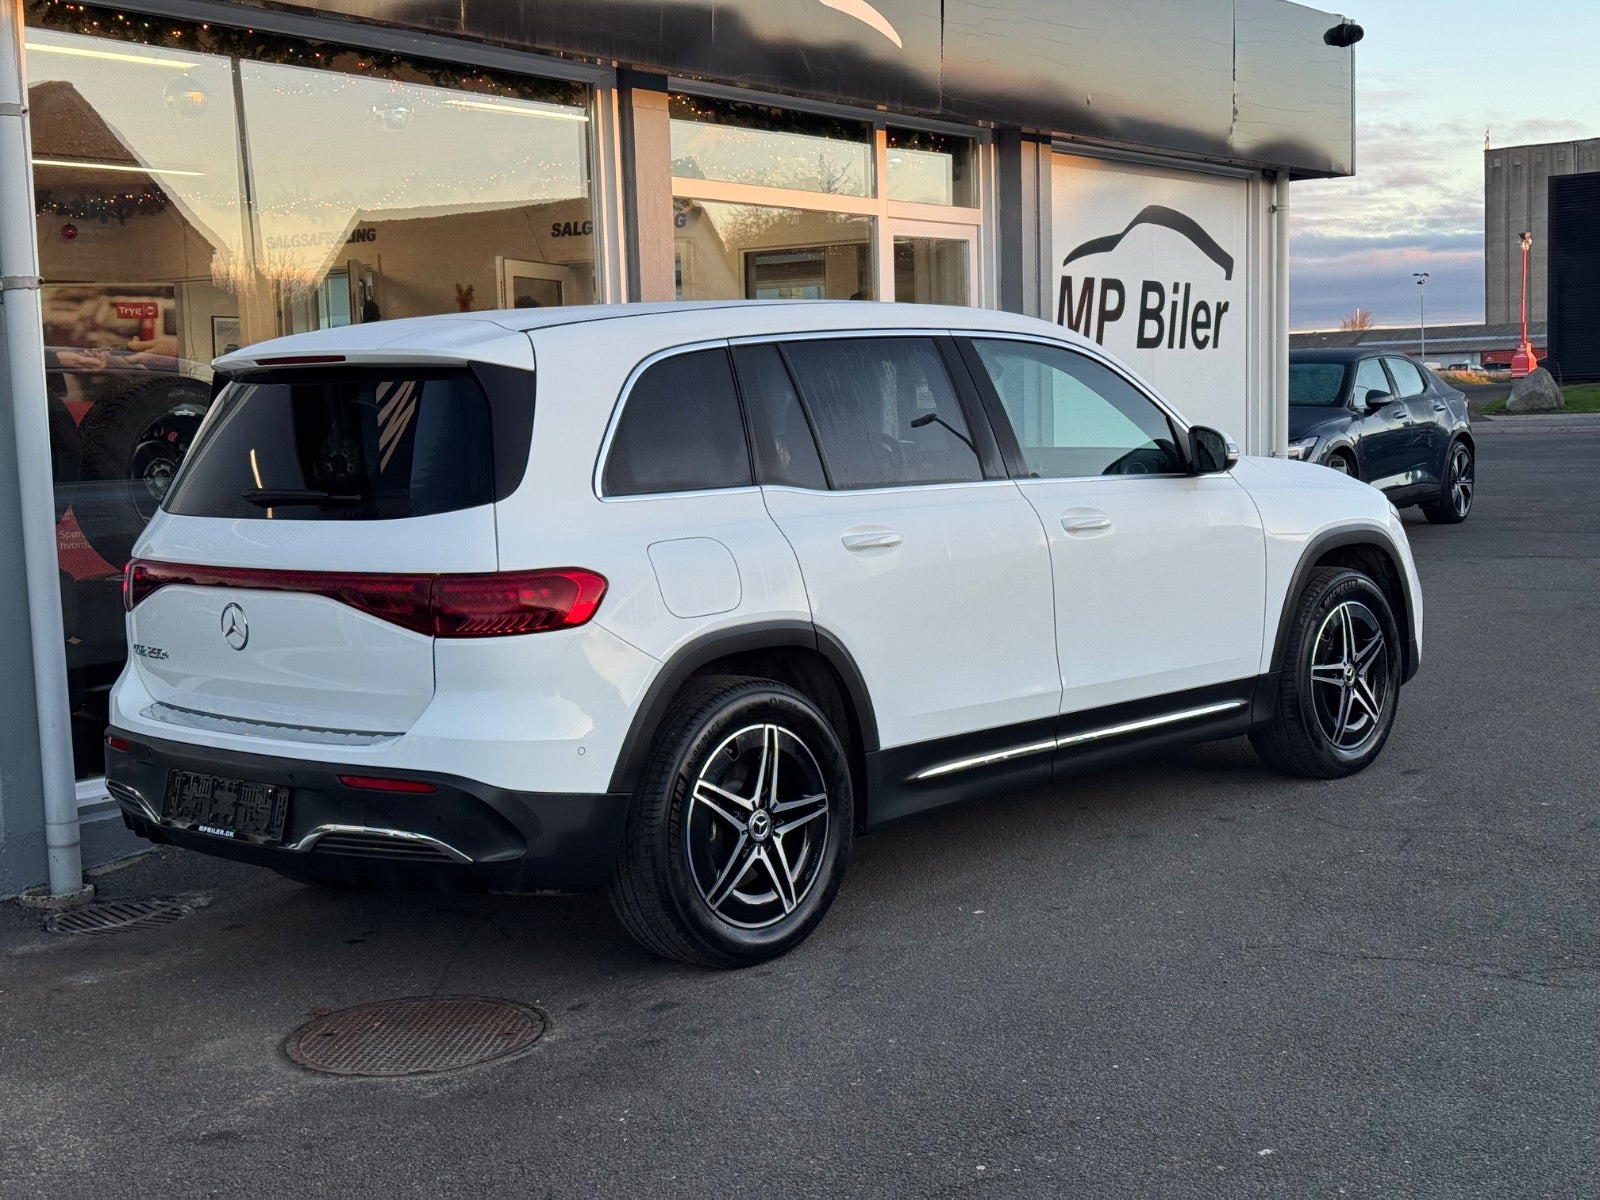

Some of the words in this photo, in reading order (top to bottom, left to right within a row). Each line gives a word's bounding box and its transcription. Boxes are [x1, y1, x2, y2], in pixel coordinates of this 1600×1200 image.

[118, 306, 142, 316] Tryg
[1057, 275, 1126, 346] MP
[1136, 280, 1230, 350] Biler
[198, 825, 235, 838] MPBILER.DK
